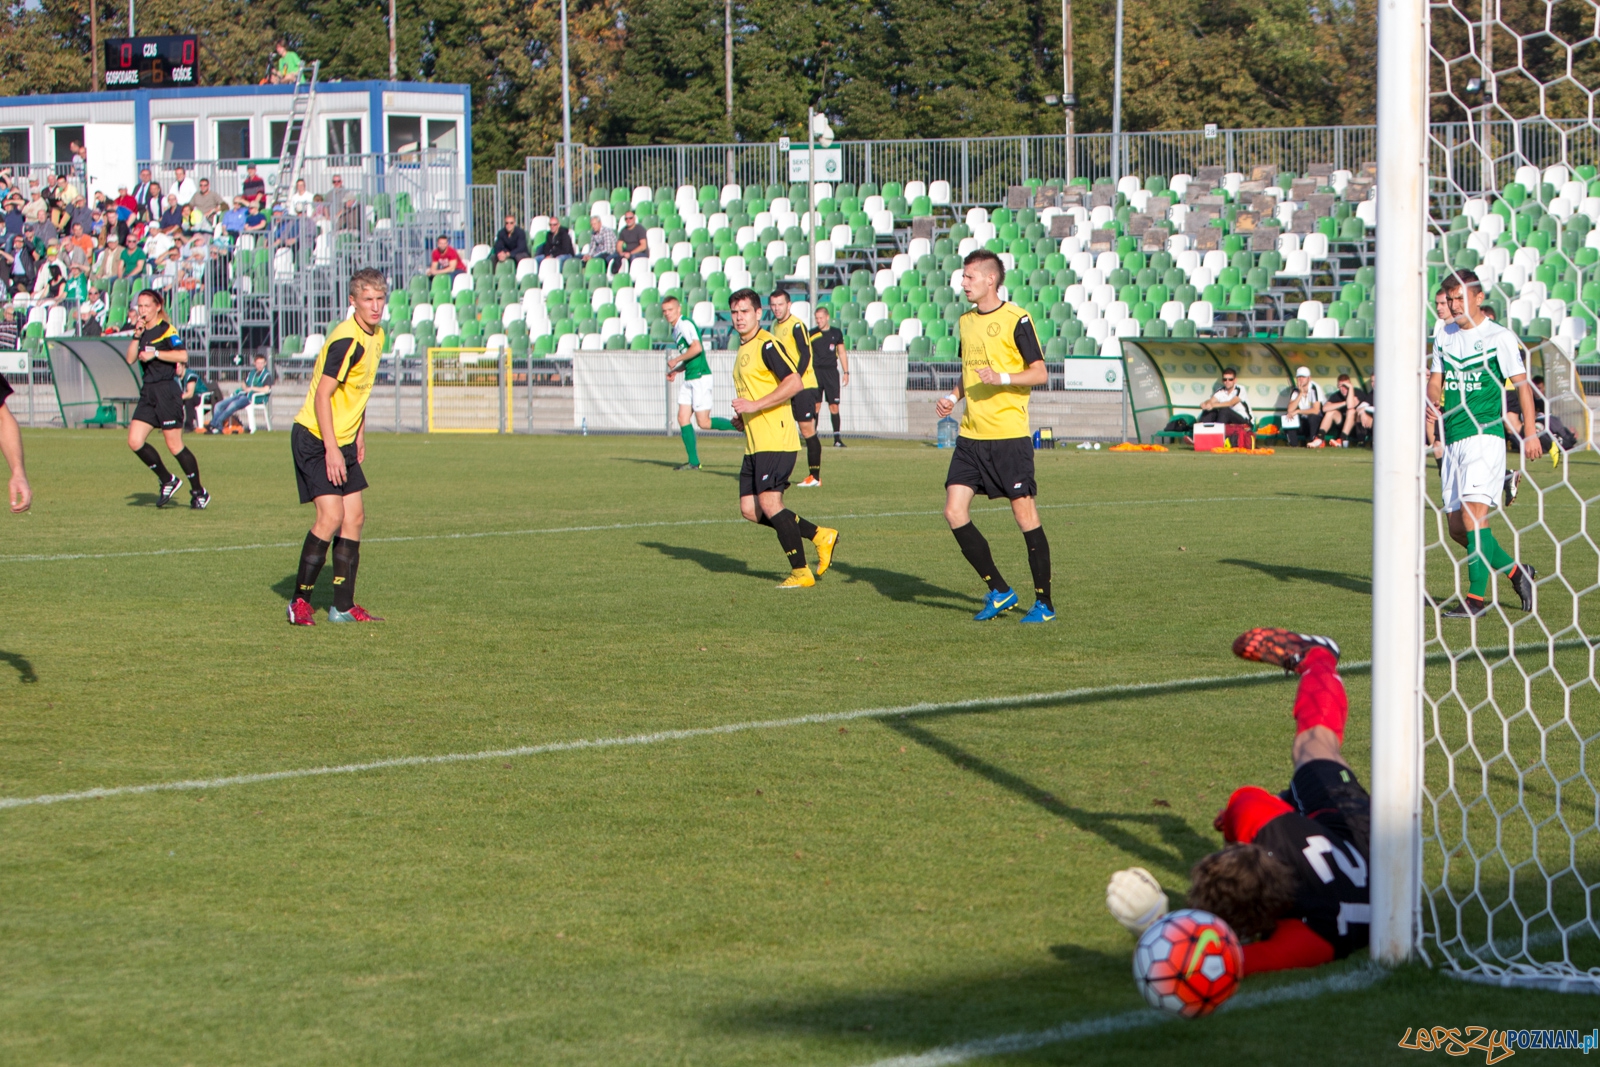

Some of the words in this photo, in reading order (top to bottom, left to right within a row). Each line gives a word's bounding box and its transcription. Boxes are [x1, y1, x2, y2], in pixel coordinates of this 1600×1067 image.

[120, 43, 132, 67] 0
[143, 42, 157, 57] CZAS
[182, 40, 195, 65] 0
[106, 69, 139, 84] GOSPODARZE
[152, 59, 164, 83] 6
[780, 141, 789, 149] 29
[1444, 370, 1482, 382] AMILY
